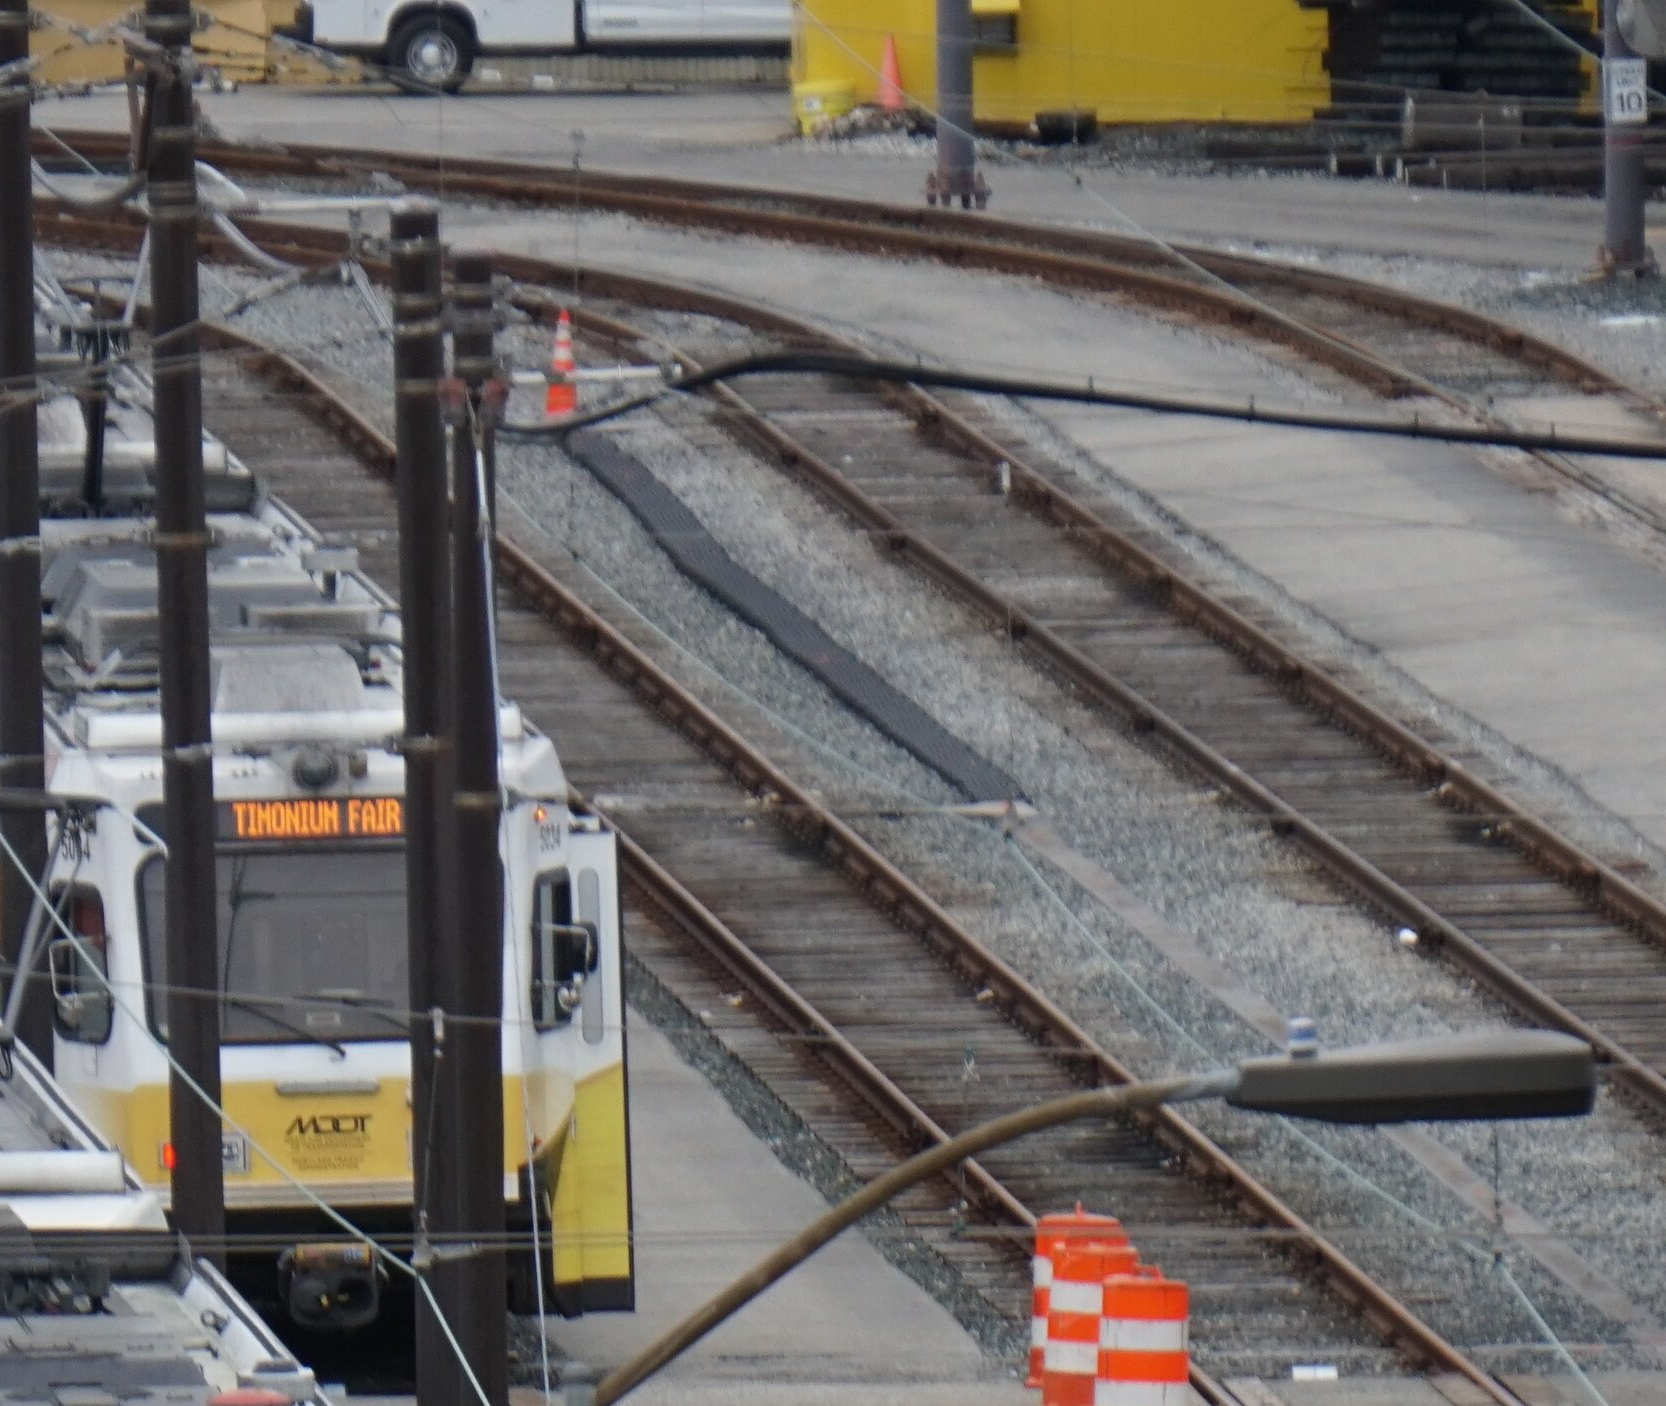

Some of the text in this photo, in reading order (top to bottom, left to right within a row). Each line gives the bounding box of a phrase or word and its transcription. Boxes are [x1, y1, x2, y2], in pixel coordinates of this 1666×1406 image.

[1616, 91, 1643, 113] 10
[232, 798, 402, 838] TIMONIUM FAIR
[61, 829, 91, 862] 504
